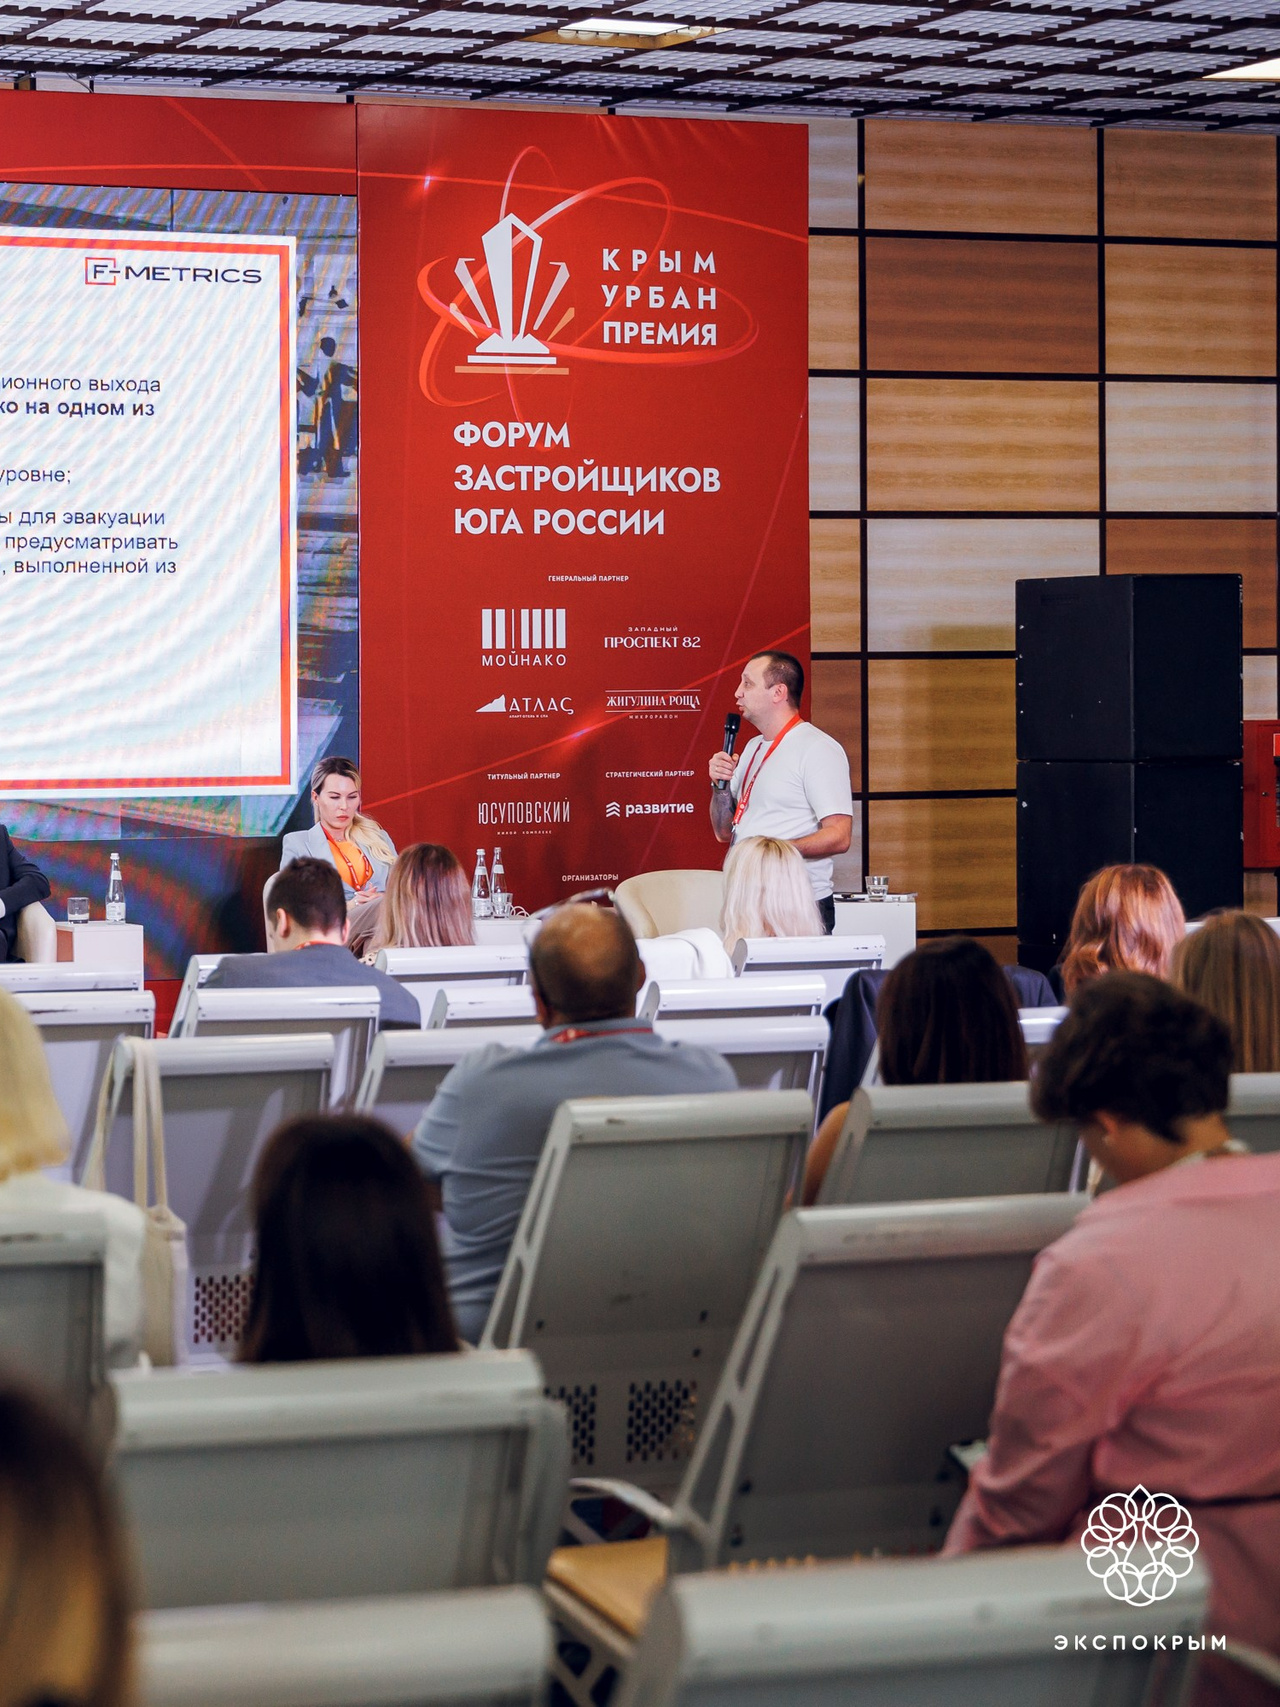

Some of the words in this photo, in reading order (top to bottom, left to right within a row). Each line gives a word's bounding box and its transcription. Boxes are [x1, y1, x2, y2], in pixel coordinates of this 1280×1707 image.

[603, 248, 716, 273] КРЫМ
[93, 264, 262, 284] F-METRICS
[601, 284, 716, 309] УРБАН
[603, 321, 716, 345] ПРЕМИЯ
[89, 379, 160, 394] выхода
[26, 402, 49, 414] на
[58, 402, 124, 418] одном
[133, 403, 154, 416] из
[454, 421, 570, 448] ФОРУМ
[454, 459, 720, 496] ЗАСТРОЙЩИКОВ
[18, 512, 56, 526] для
[63, 512, 164, 528] эвакуации
[455, 508, 523, 534] ЮГА
[534, 509, 664, 535] РОССИИ
[5, 536, 178, 553] предусматривать
[14, 558, 148, 573] выполненной
[156, 561, 176, 573] из
[548, 574, 597, 582] ГЕНЕРАЛЬНЫЙ
[604, 637, 679, 648] ПРОСПЕКТ
[682, 637, 701, 648] 82
[607, 696, 666, 706] ЖИГУЛИНА
[669, 696, 700, 709] РОЩА
[487, 772, 528, 780] ТИТУЛЬНЫЙ
[605, 770, 663, 778] СТРАТЕГИЧЕСКИЙ
[478, 797, 569, 824] ЮСУПОВСКИЙ
[626, 803, 694, 817] развитие
[562, 874, 618, 882] ОРГАНИЗАТОРЫ
